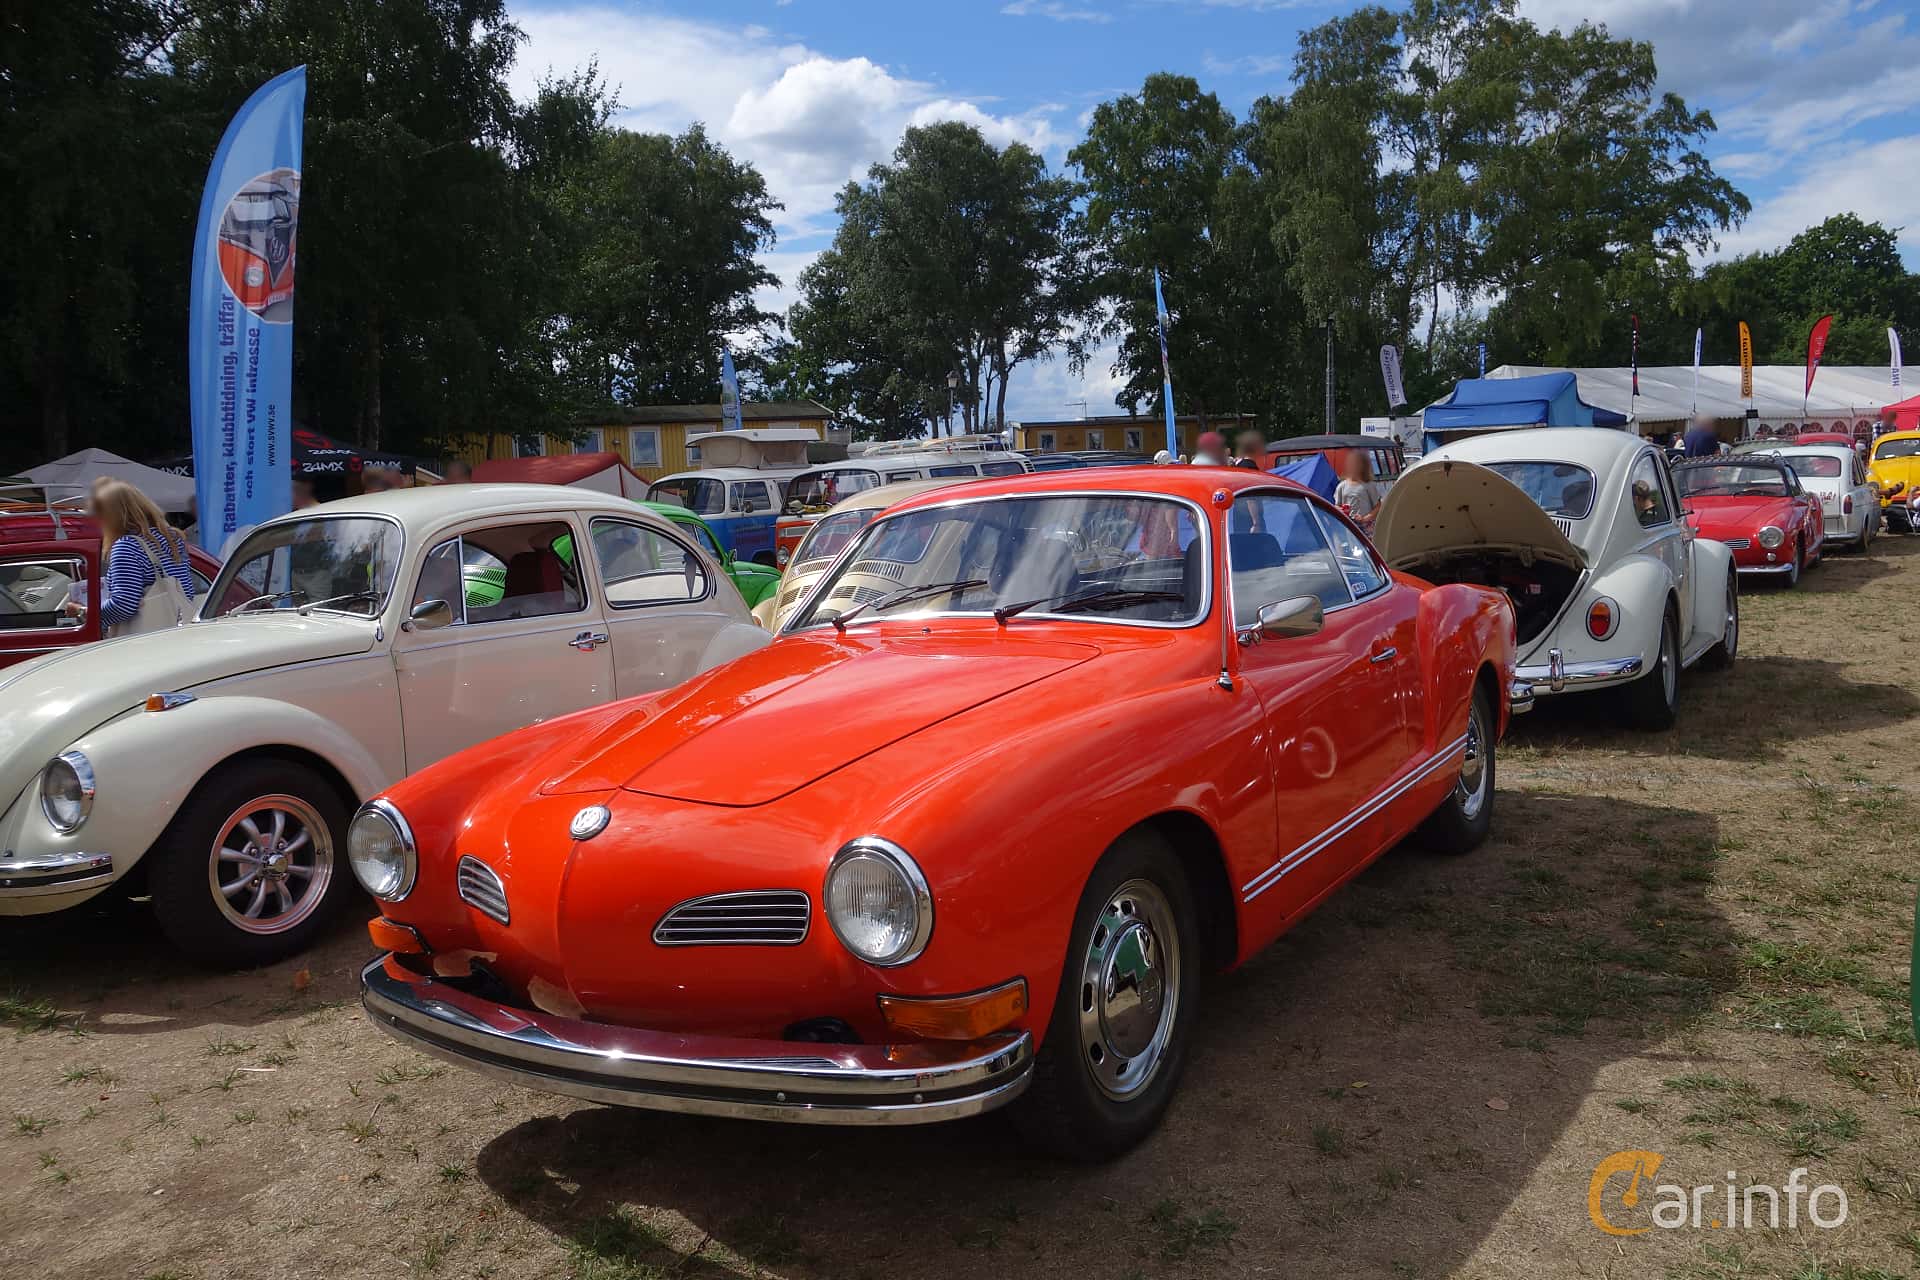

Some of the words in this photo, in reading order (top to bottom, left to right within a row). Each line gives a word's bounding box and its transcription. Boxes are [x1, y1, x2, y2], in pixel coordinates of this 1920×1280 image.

[218, 293, 235, 346] träffar
[245, 328, 260, 393] intresse
[221, 351, 239, 457] klubbtidning,
[245, 398, 257, 424] VW
[245, 428, 256, 465] stort
[302, 461, 345, 473] 24MX
[222, 461, 238, 533] Rabatter,
[244, 470, 254, 499] och
